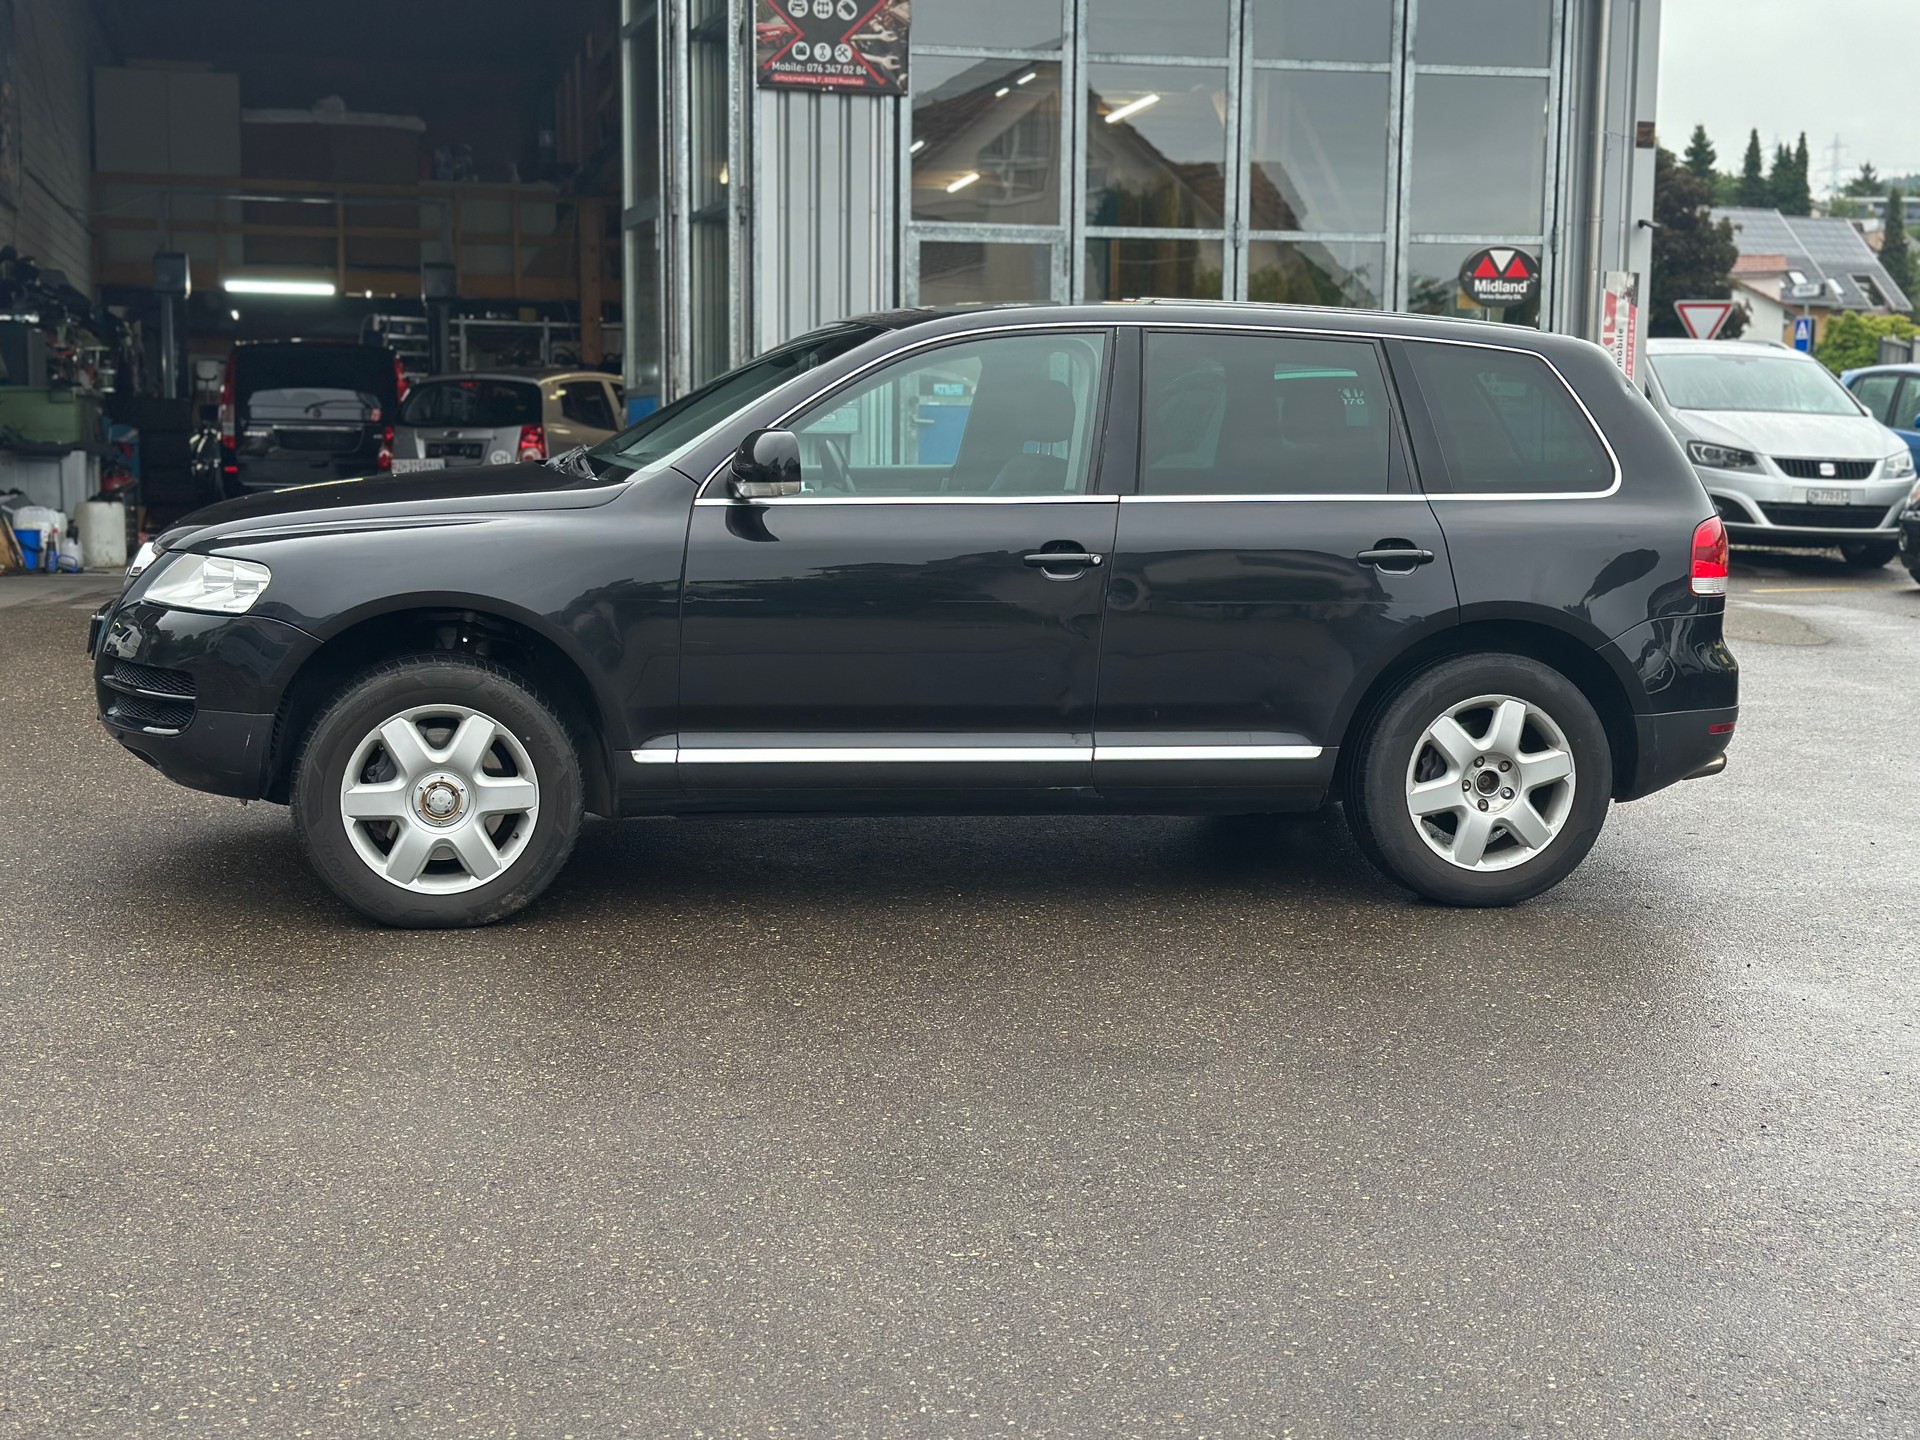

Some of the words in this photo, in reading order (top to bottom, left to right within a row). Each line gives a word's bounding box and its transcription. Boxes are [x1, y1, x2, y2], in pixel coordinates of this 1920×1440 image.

[772, 62, 805, 72] Mobile:
[807, 63, 823, 73] 076
[825, 64, 841, 74] 347
[843, 65, 854, 74] 02
[856, 66, 867, 75] 84
[1474, 279, 1527, 293] Midland
[1495, 293, 1513, 301] Quality
